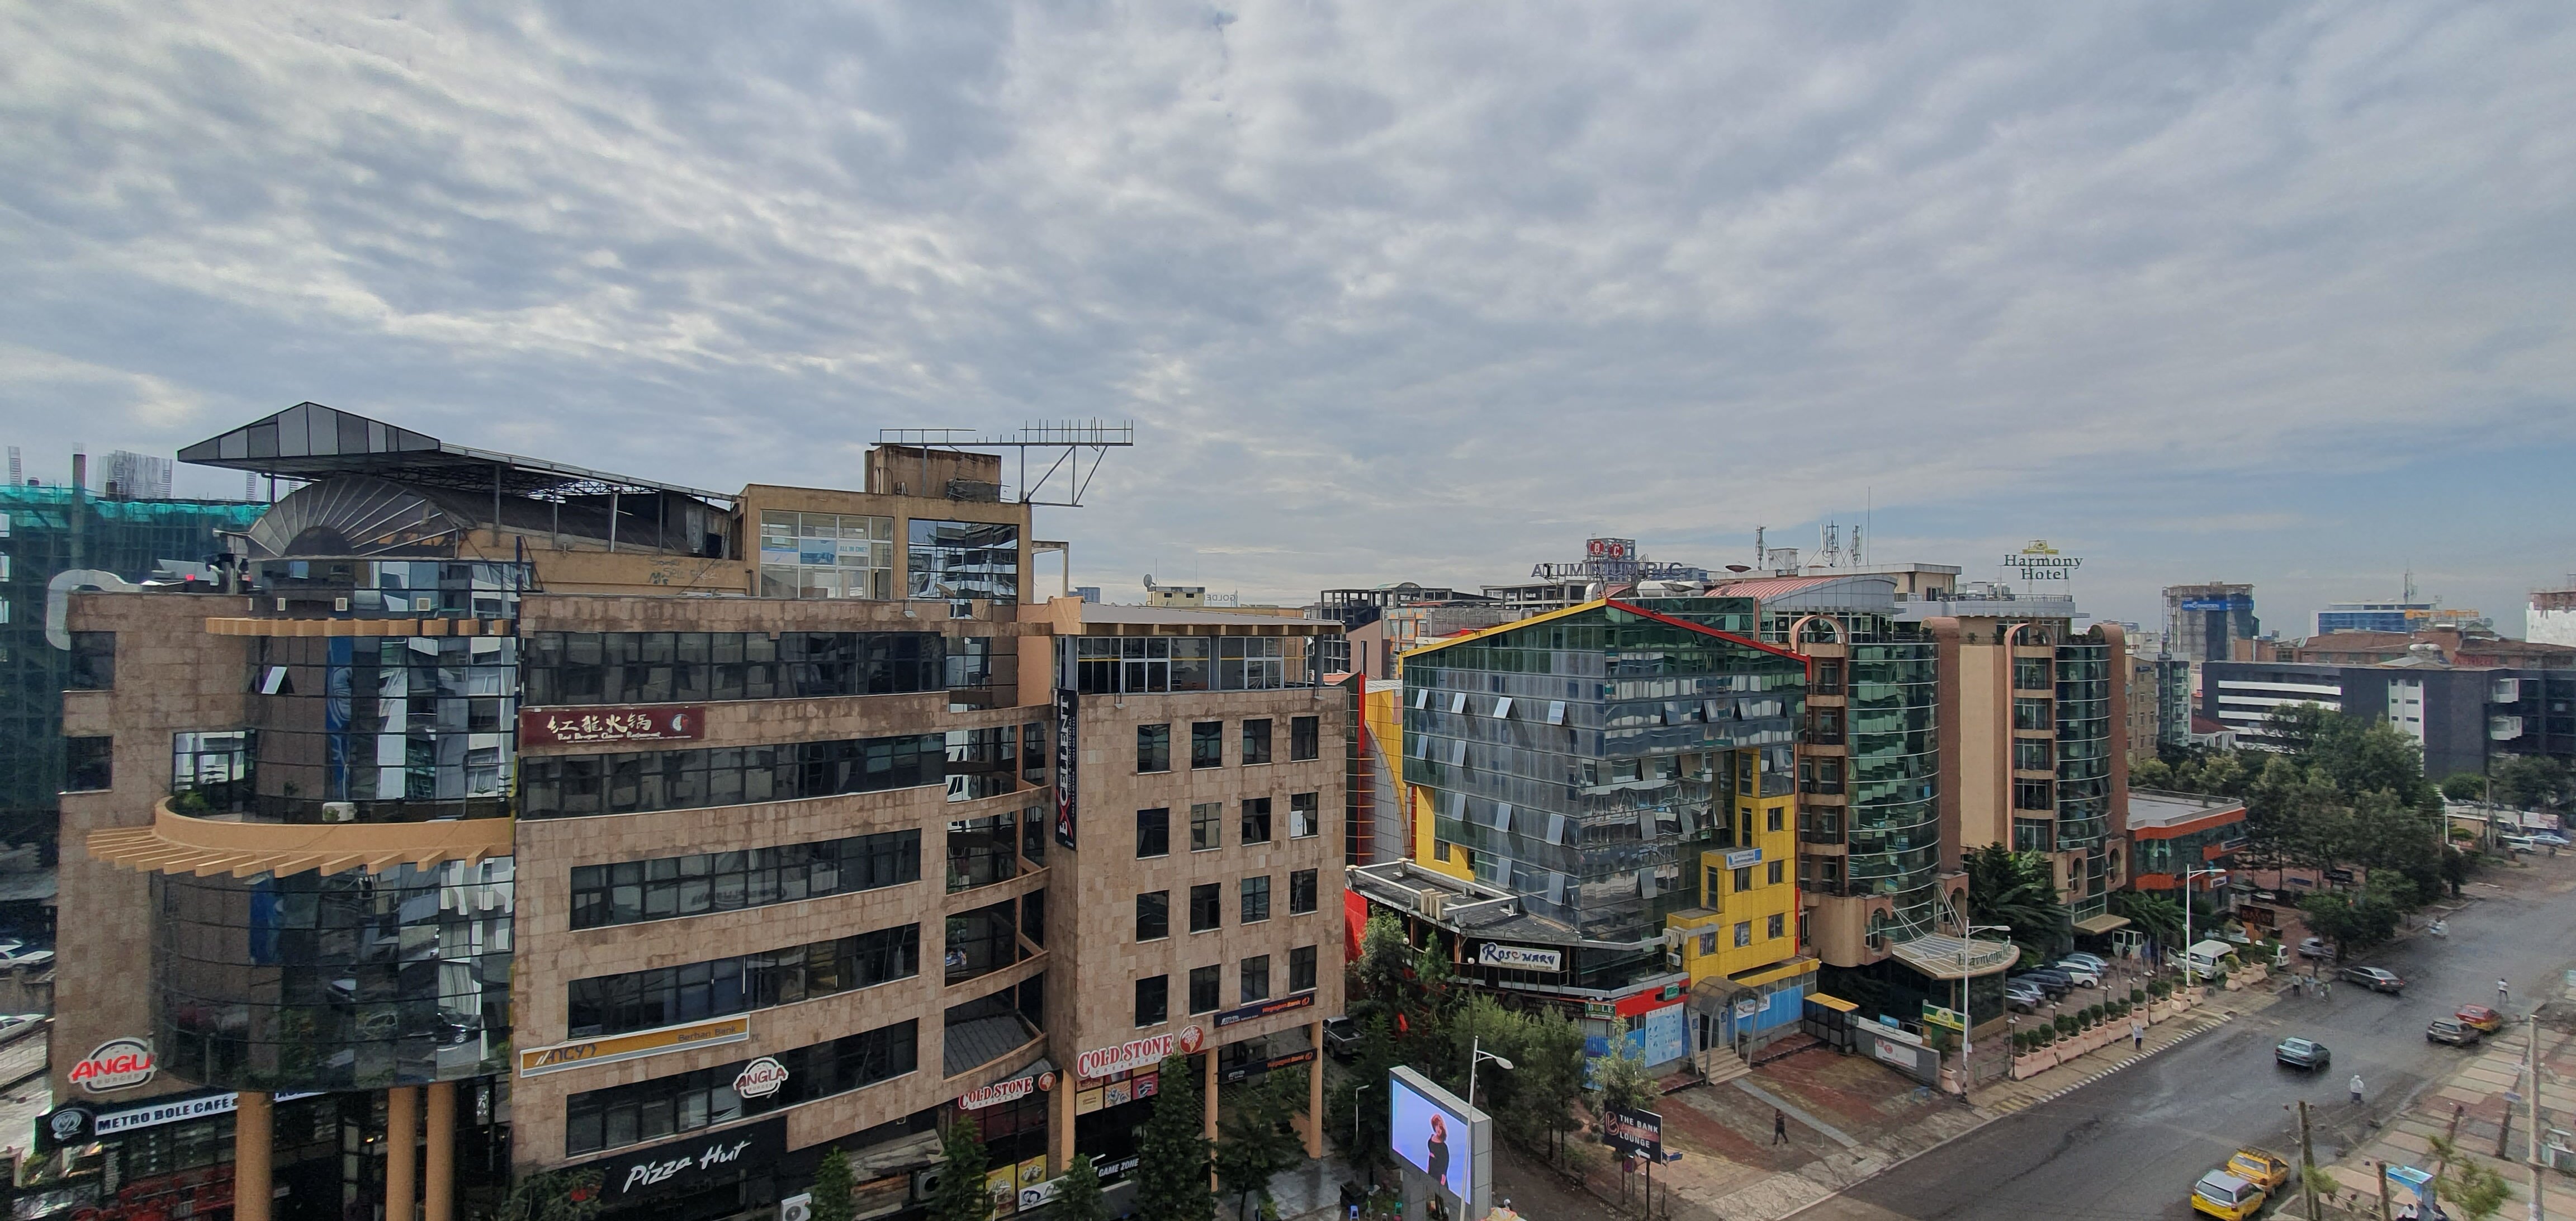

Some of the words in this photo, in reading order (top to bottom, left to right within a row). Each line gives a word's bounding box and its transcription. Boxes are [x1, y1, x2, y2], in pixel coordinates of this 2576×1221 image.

[1594, 543, 1600, 553] B
[1614, 546, 1620, 556] C
[1645, 562, 1683, 576] PLC
[2004, 554, 2083, 570] Harmony
[2021, 568, 2069, 580] Hotel
[1057, 695, 1071, 837] EXCELLENT
[678, 1031, 711, 1042] Berhan
[714, 1026, 736, 1035] Bank
[1078, 1047, 1120, 1076] COLD
[1123, 1034, 1173, 1062] STONE
[1096, 1056, 1158, 1075] CREAMERY
[736, 1067, 787, 1091] ANGLA
[749, 1083, 773, 1091] BURGER
[959, 1087, 991, 1109] COLD
[993, 1078, 1033, 1098] STONE
[98, 1112, 150, 1132] METRO
[154, 1105, 190, 1120] BOLE
[194, 1096, 229, 1113] CAFÉ
[1620, 1114, 1634, 1125] THE
[1637, 1120, 1658, 1133] BANK
[1620, 1131, 1650, 1148] LOUNGE
[622, 1157, 693, 1193] Pizza
[699, 1140, 751, 1170] Hut
[1098, 1164, 1119, 1177] GAME
[1120, 1158, 1140, 1171] ZONE
